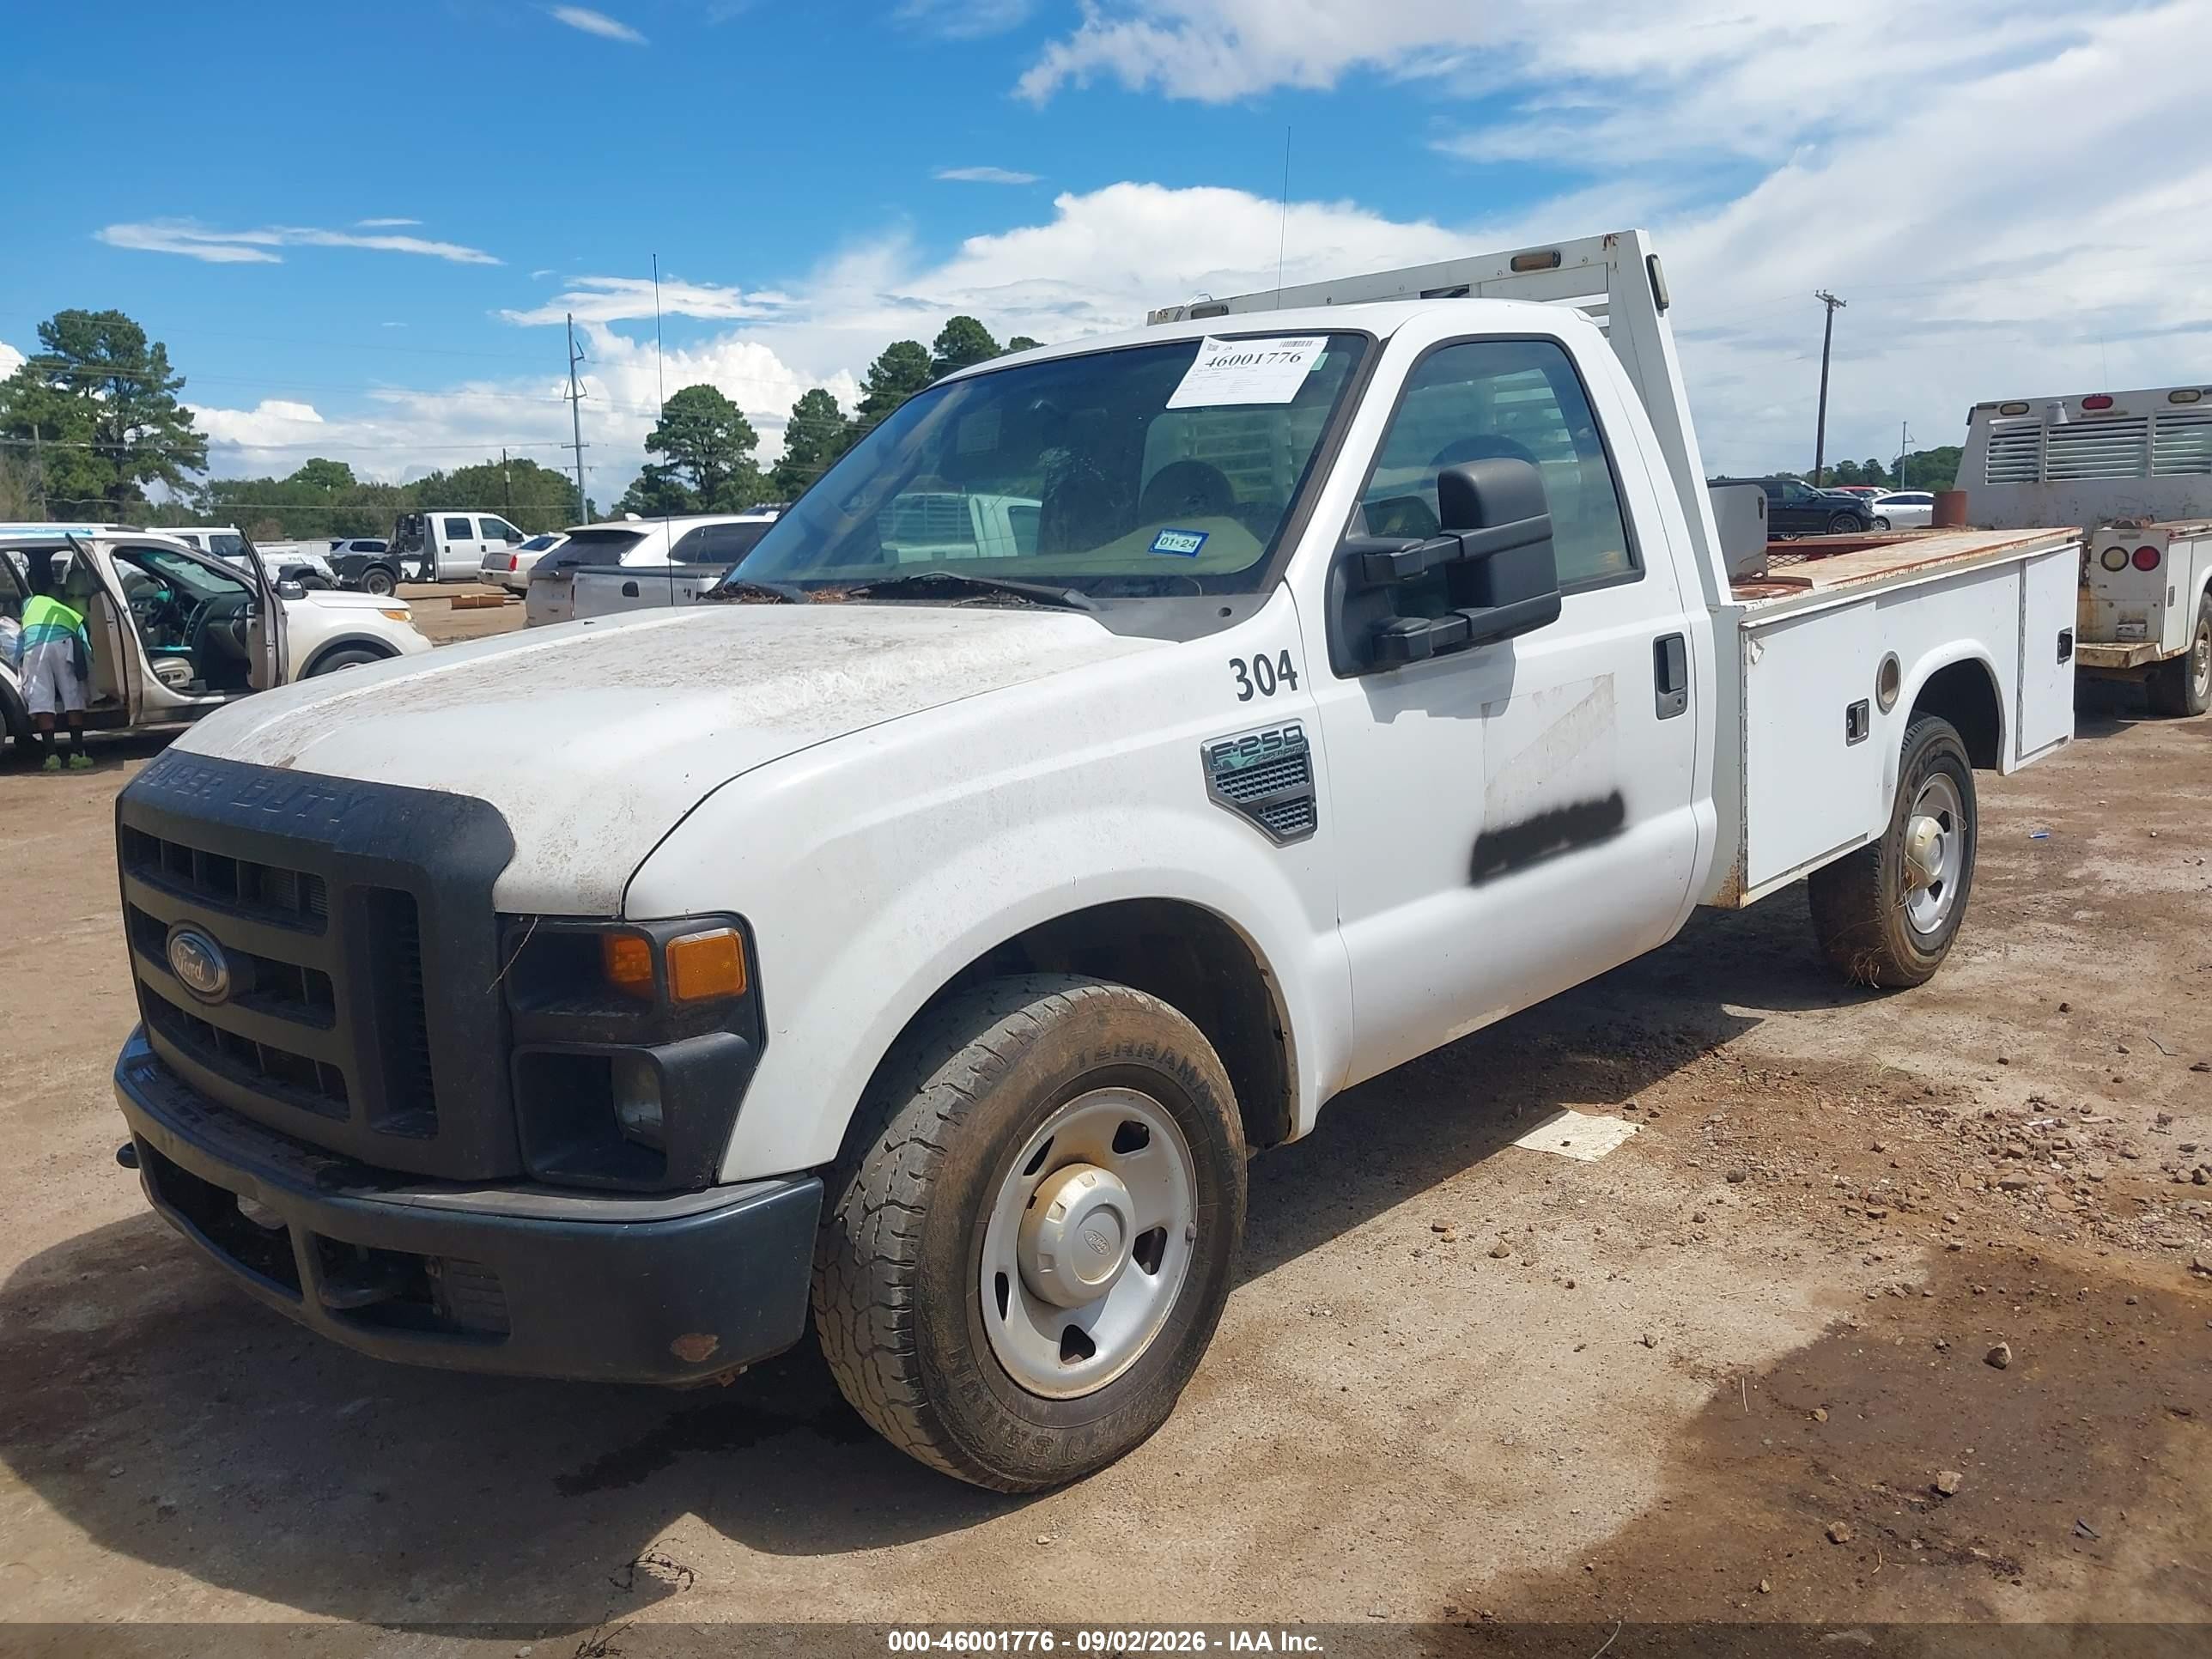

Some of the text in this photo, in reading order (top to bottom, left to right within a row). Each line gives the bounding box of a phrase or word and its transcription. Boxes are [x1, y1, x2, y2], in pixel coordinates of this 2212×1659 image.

[1205, 350, 1304, 368] 46001776
[1229, 649, 1298, 702] 304
[1210, 725, 1304, 764] F-250
[137, 758, 379, 823] SUPER DUTY
[177, 943, 205, 981] Ford
